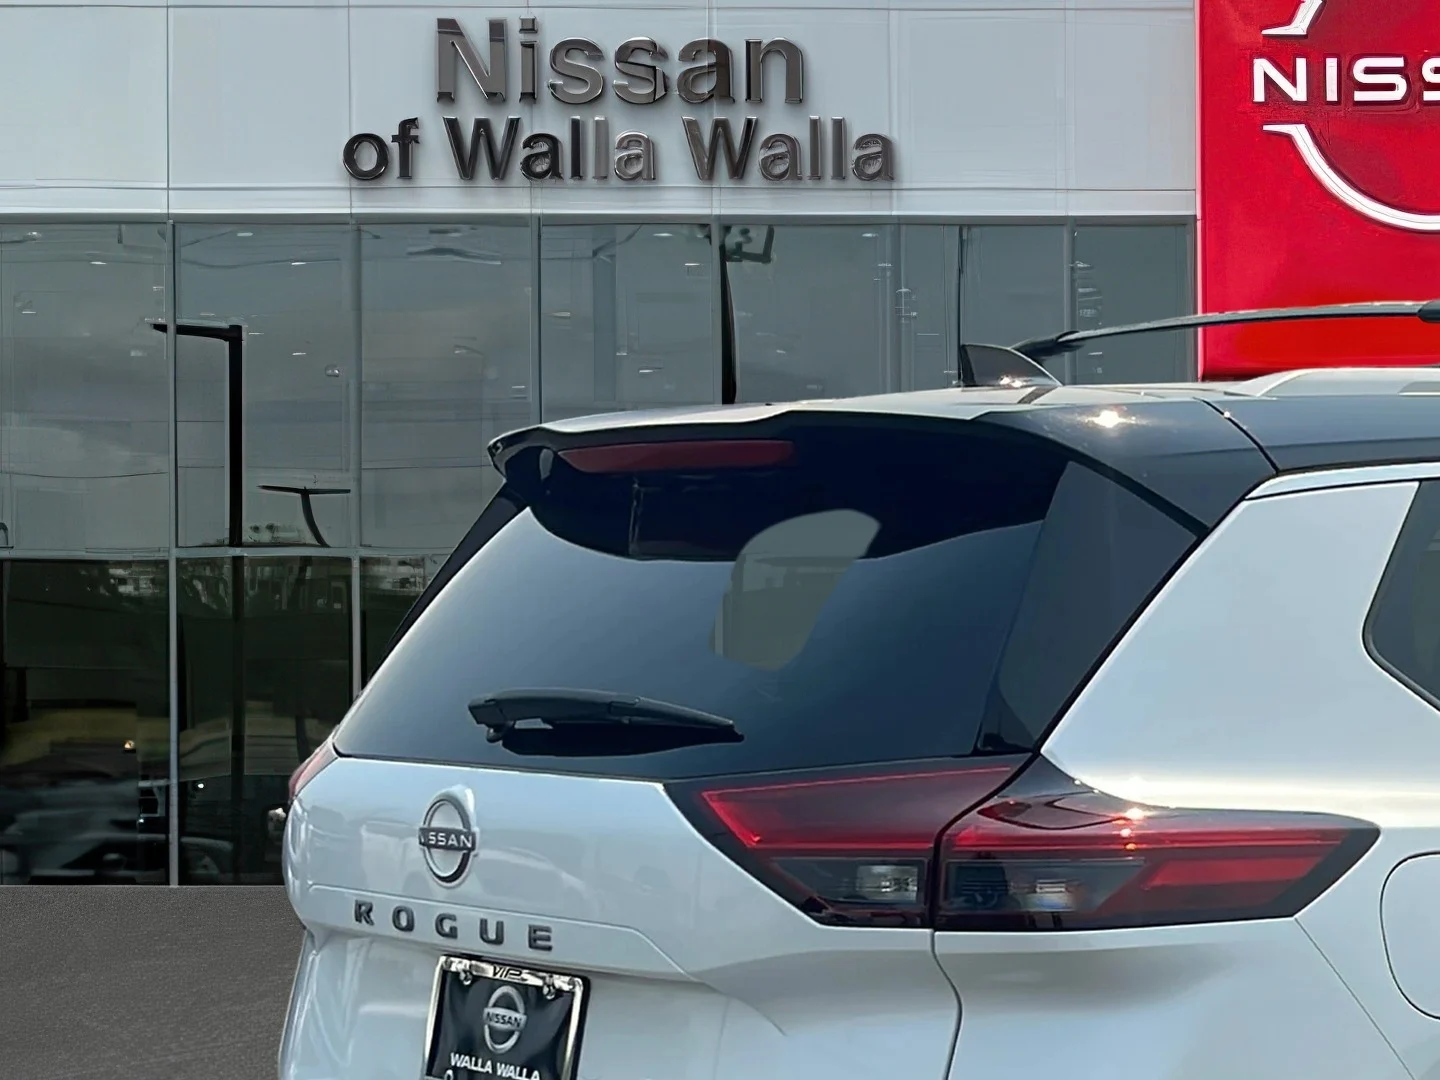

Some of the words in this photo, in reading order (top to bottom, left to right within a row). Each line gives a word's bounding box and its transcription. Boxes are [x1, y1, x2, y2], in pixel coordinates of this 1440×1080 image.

[436, 15, 804, 104] Nissan
[342, 116, 420, 181] of
[443, 115, 655, 181] Walla
[681, 115, 894, 182] Walla
[420, 831, 472, 848] NSSAN
[354, 899, 553, 952] ROGUE
[486, 1010, 521, 1029] NISSAN
[450, 1052, 493, 1074] WALLA
